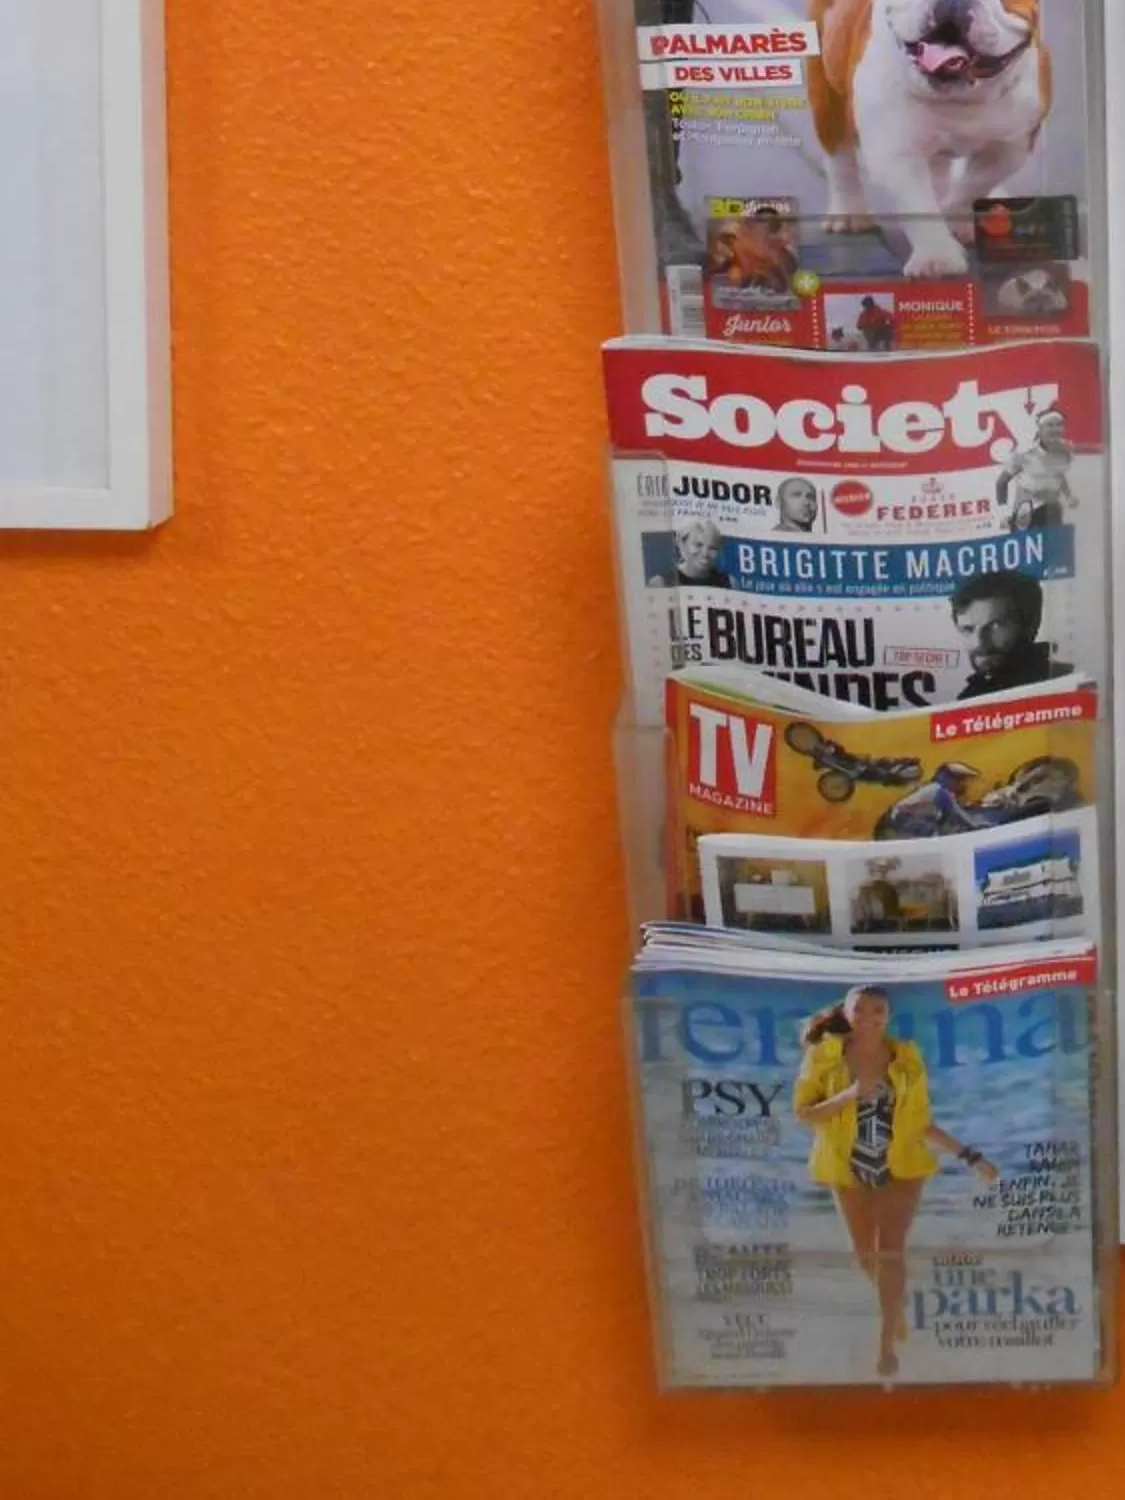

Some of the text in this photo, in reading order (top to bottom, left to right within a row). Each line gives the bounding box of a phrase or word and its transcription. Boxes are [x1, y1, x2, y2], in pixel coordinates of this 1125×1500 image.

[651, 27, 808, 57] PALMARÈS
[674, 64, 793, 82] DES VILLES
[898, 300, 965, 313] MONIQUE
[641, 372, 1060, 463] Society
[672, 475, 773, 507] JUDOR
[876, 498, 992, 521] FEDERER
[738, 531, 1043, 581] BRIGITTE MACRON
[706, 607, 876, 669] BUREAU
[934, 702, 1084, 739] Le Télégramme
[688, 702, 774, 798] TV
[688, 782, 774, 816] MAGAZINE
[949, 968, 1078, 999] Le Télégramme
[680, 1079, 784, 1119] PSY
[973, 1195, 998, 1209] NE
[912, 1269, 1082, 1331] parka
